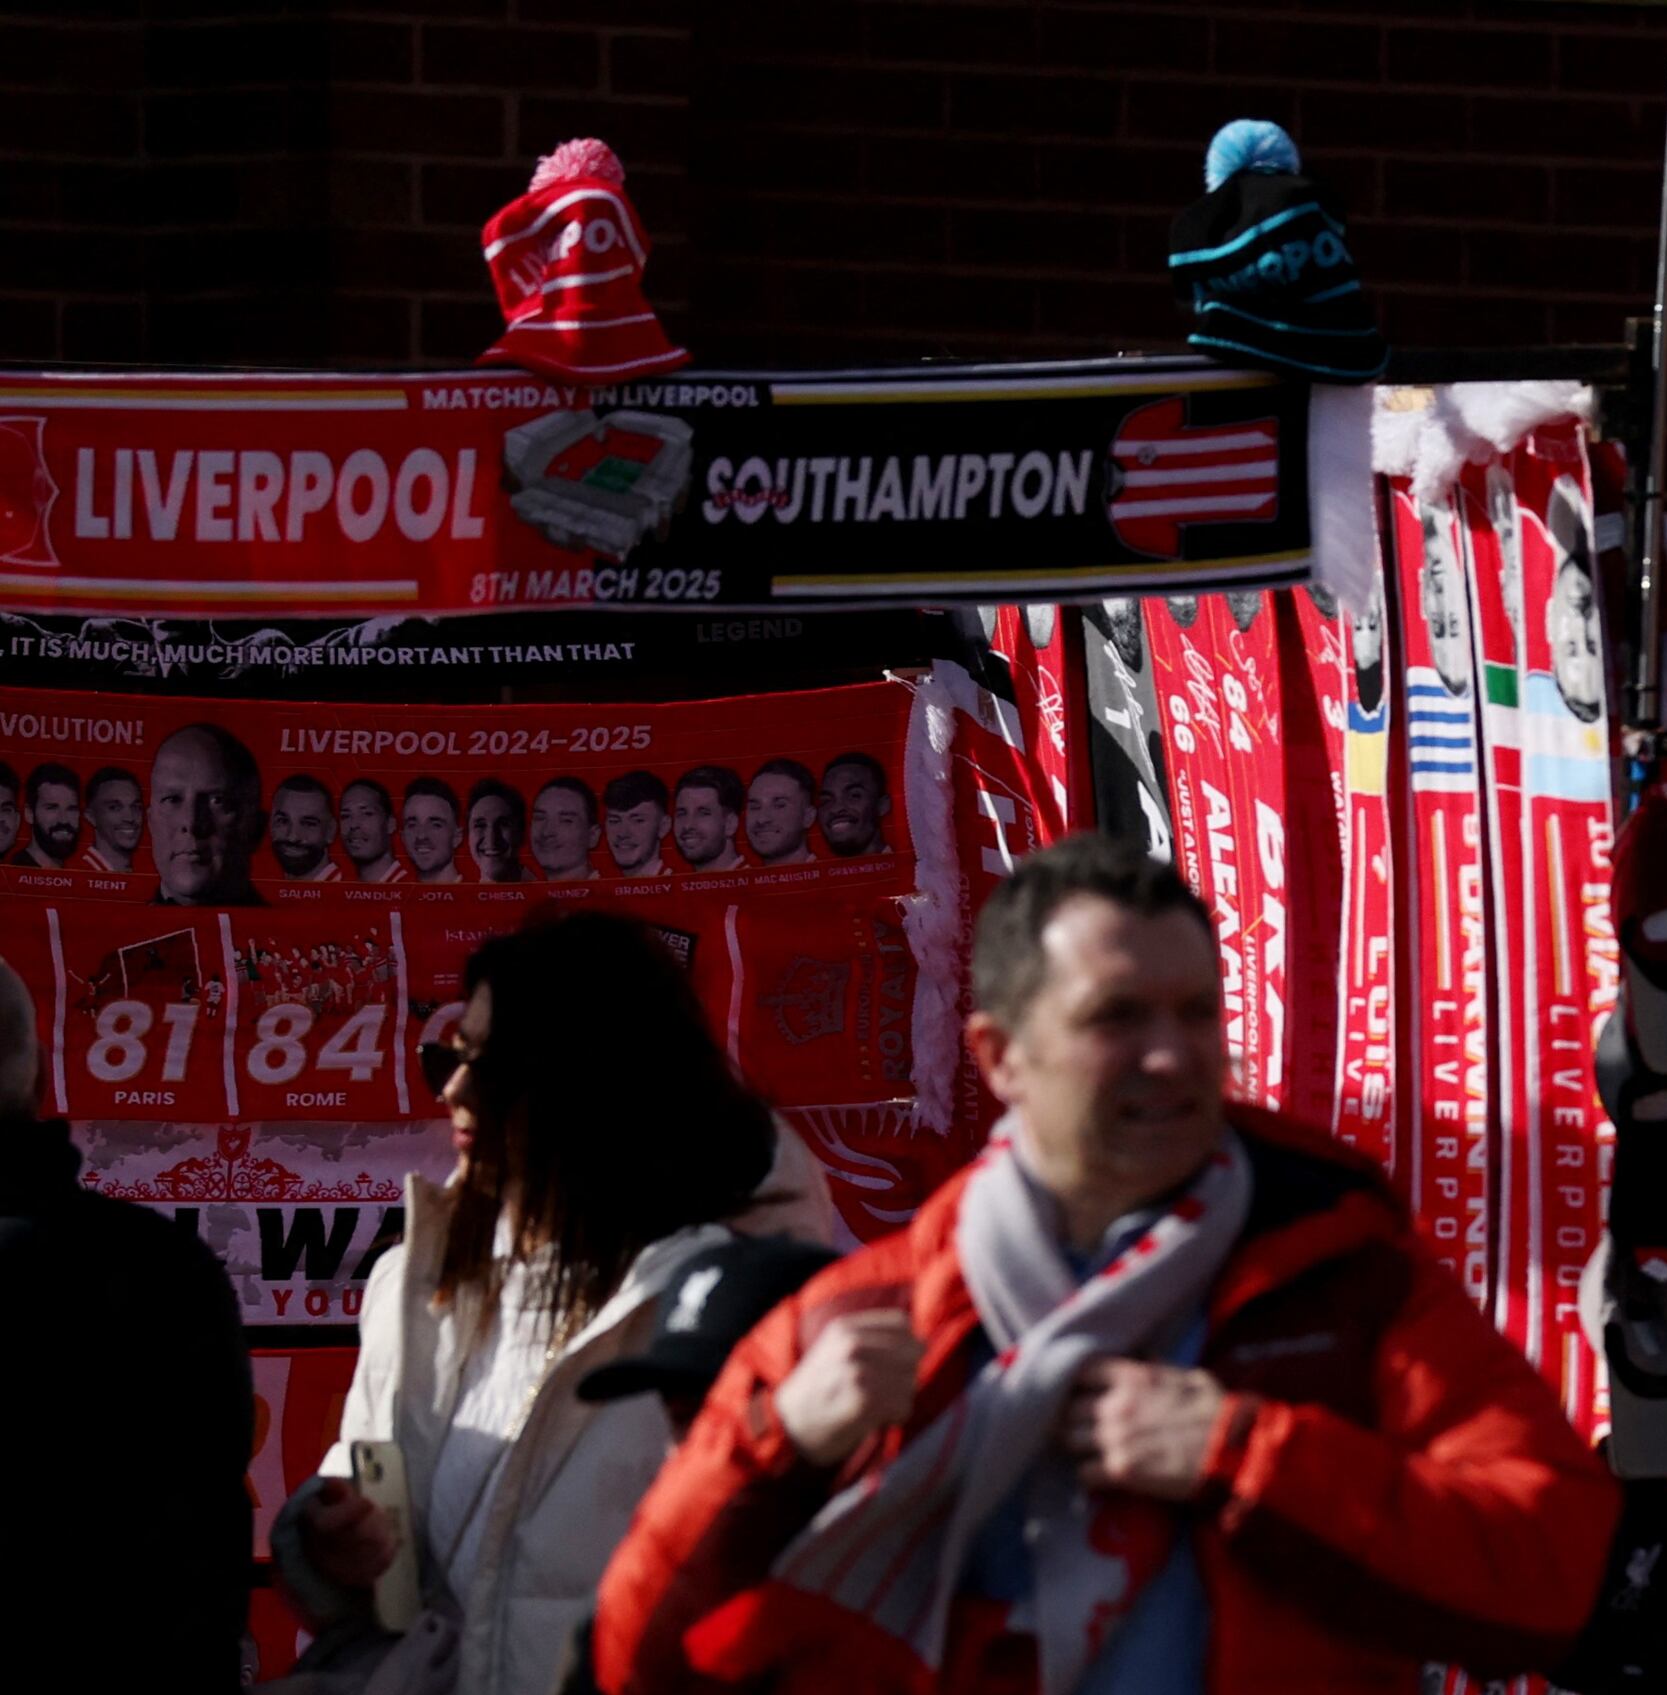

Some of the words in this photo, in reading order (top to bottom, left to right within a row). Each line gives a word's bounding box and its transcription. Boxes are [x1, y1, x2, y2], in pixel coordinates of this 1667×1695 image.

[423, 387, 573, 409] MATCHDAY
[623, 386, 758, 407] LIVERPOOL
[76, 448, 484, 542] LIVERPOOL
[703, 451, 1092, 523] SOUTHAMPTON
[470, 572, 518, 603] 8TH
[526, 569, 638, 599] MARCH
[645, 569, 721, 599] 2025
[12, 637, 35, 655] IT
[40, 636, 62, 657] IS
[161, 640, 243, 669] MUCH
[250, 647, 323, 664] MORE
[329, 647, 483, 664] IMPORTANT
[488, 645, 563, 663] THAN
[571, 643, 635, 660] THAT
[281, 729, 461, 755] LIVERPOOL
[468, 726, 651, 754] 2024-2025
[85, 1000, 201, 1083] 81
[244, 1003, 388, 1086] 84
[115, 1091, 174, 1104] PARIS
[287, 1093, 346, 1106] ROME
